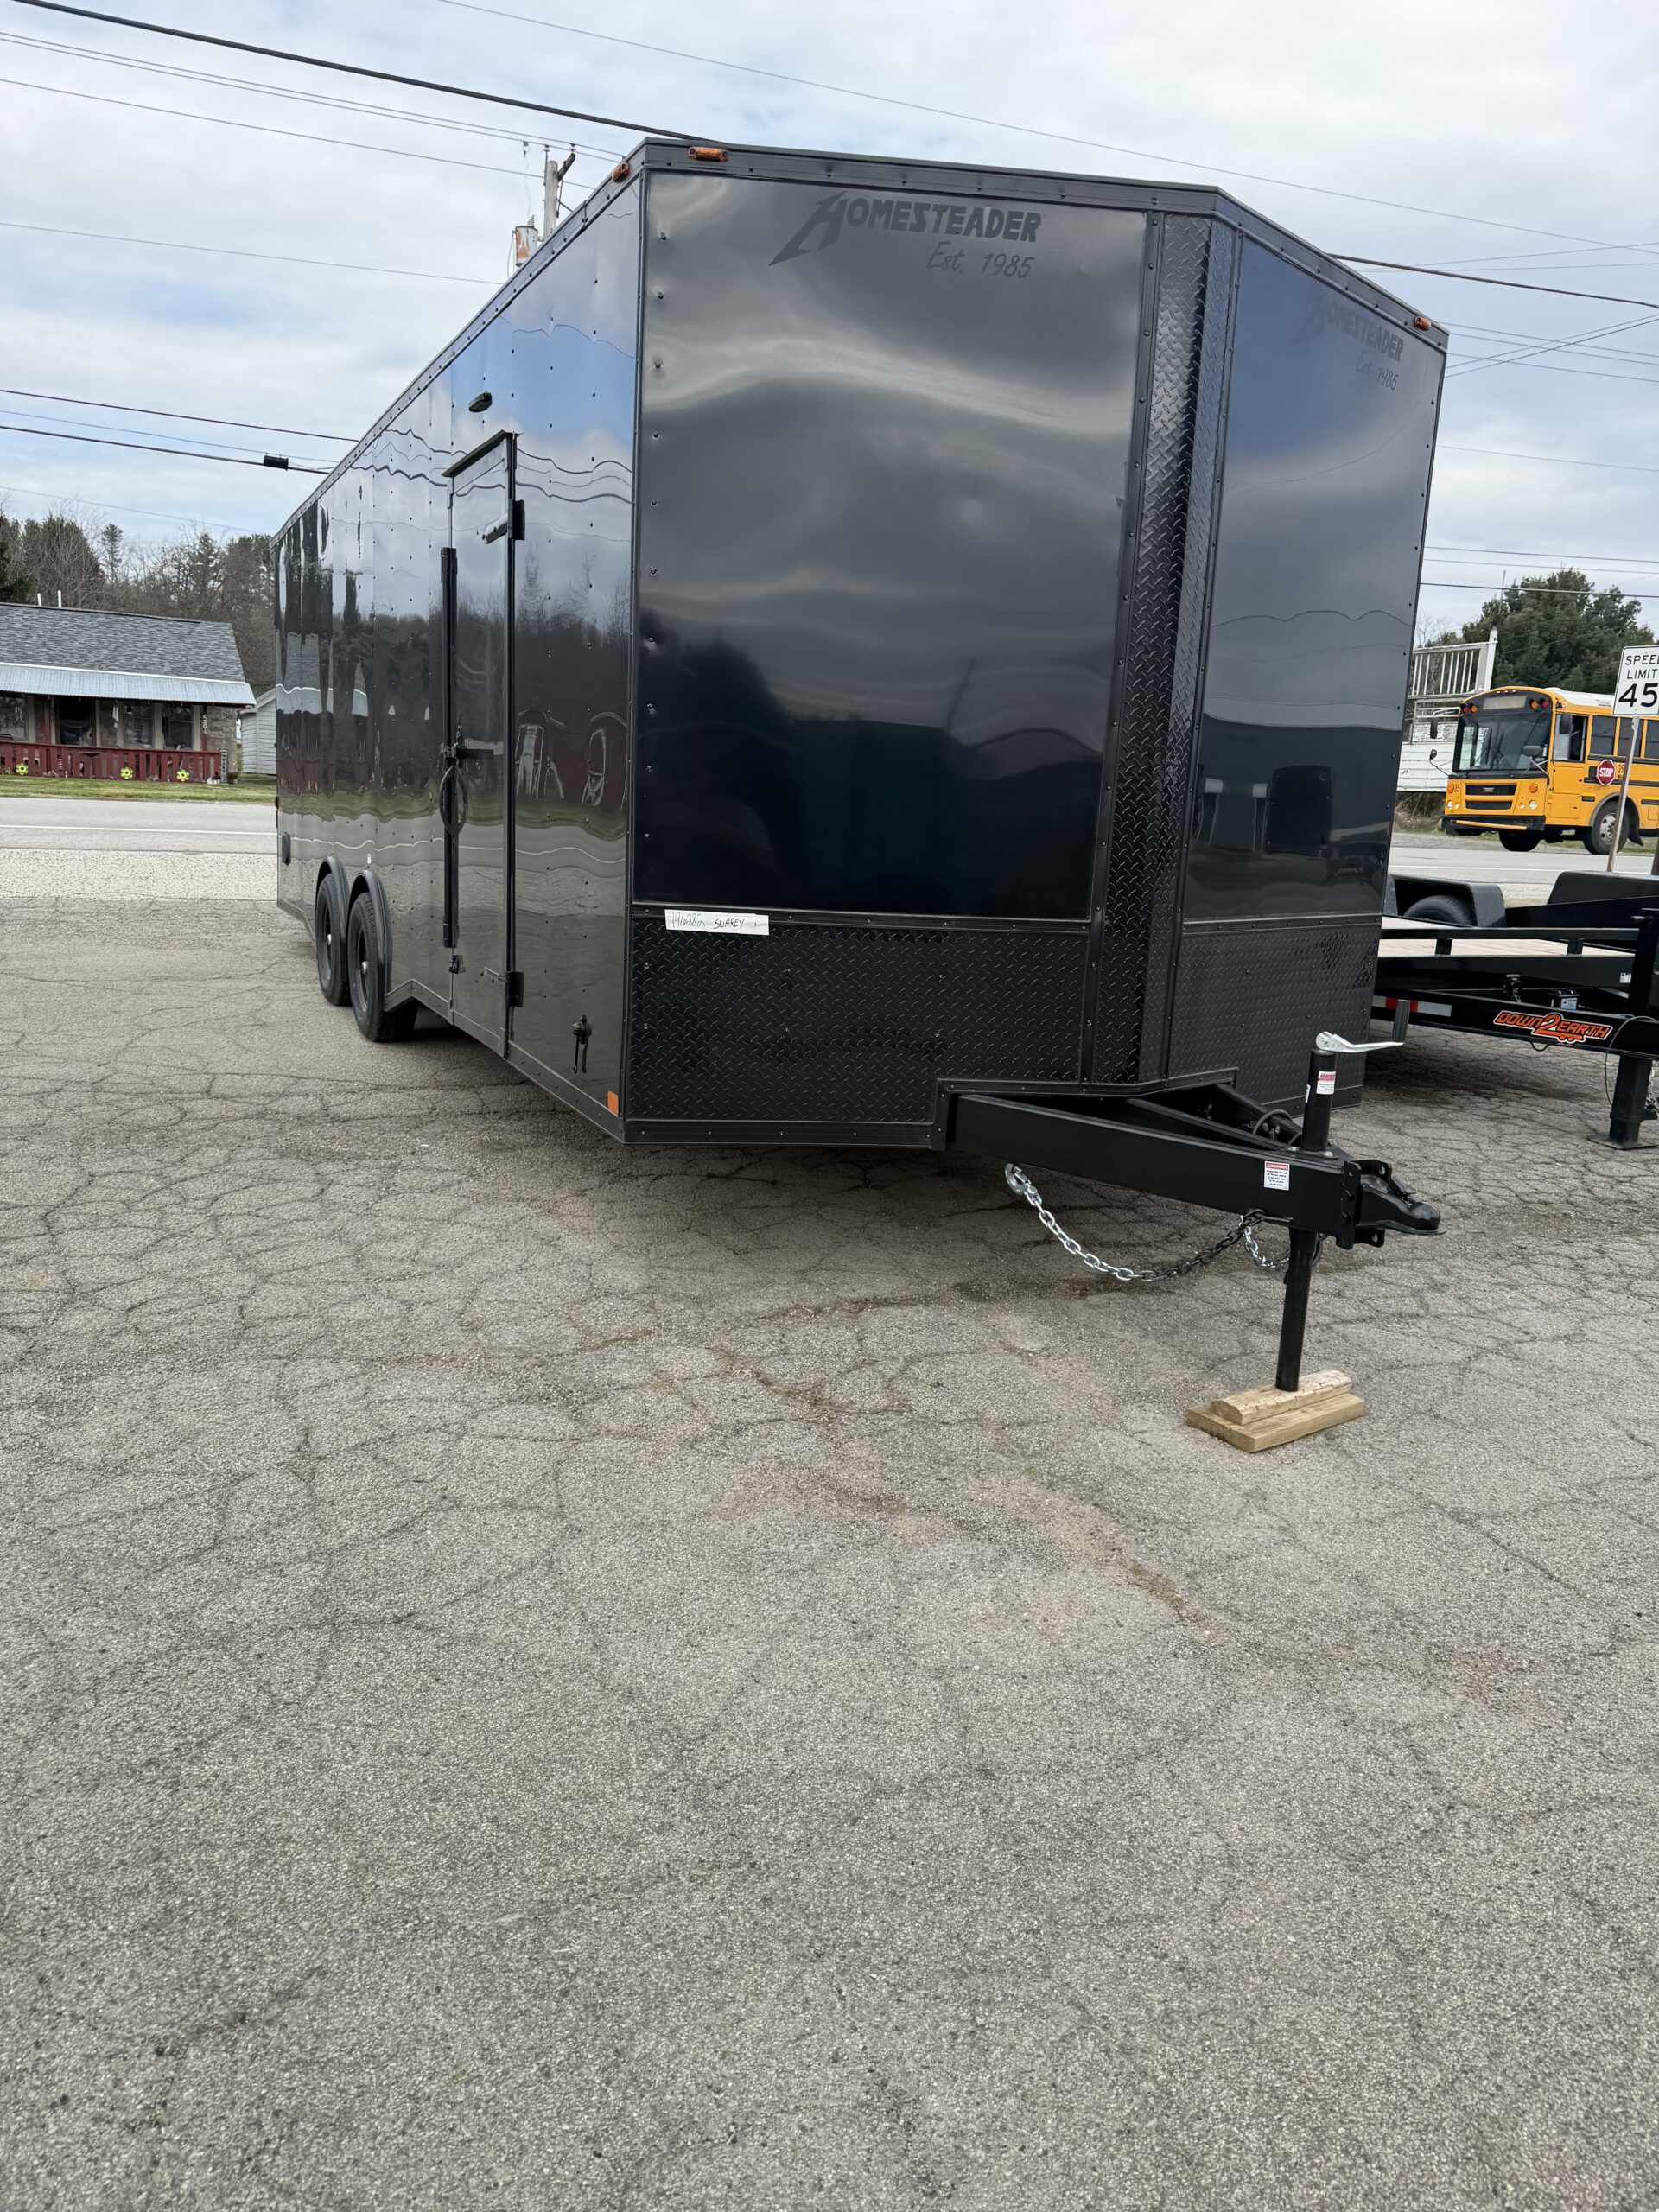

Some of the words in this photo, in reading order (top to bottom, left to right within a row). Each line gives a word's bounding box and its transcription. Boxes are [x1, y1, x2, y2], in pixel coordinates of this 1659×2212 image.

[768, 190, 1042, 267] HOMESTEADER
[926, 240, 964, 274] Est.
[981, 252, 1035, 278] 1985
[1292, 296, 1405, 363] HOMESTEADER
[1376, 365, 1400, 391] 1985
[1625, 654, 1659, 665] SPEE
[1626, 668, 1658, 680] LIMIT
[1618, 683, 1658, 708] 45
[1599, 767, 1614, 778] STOP
